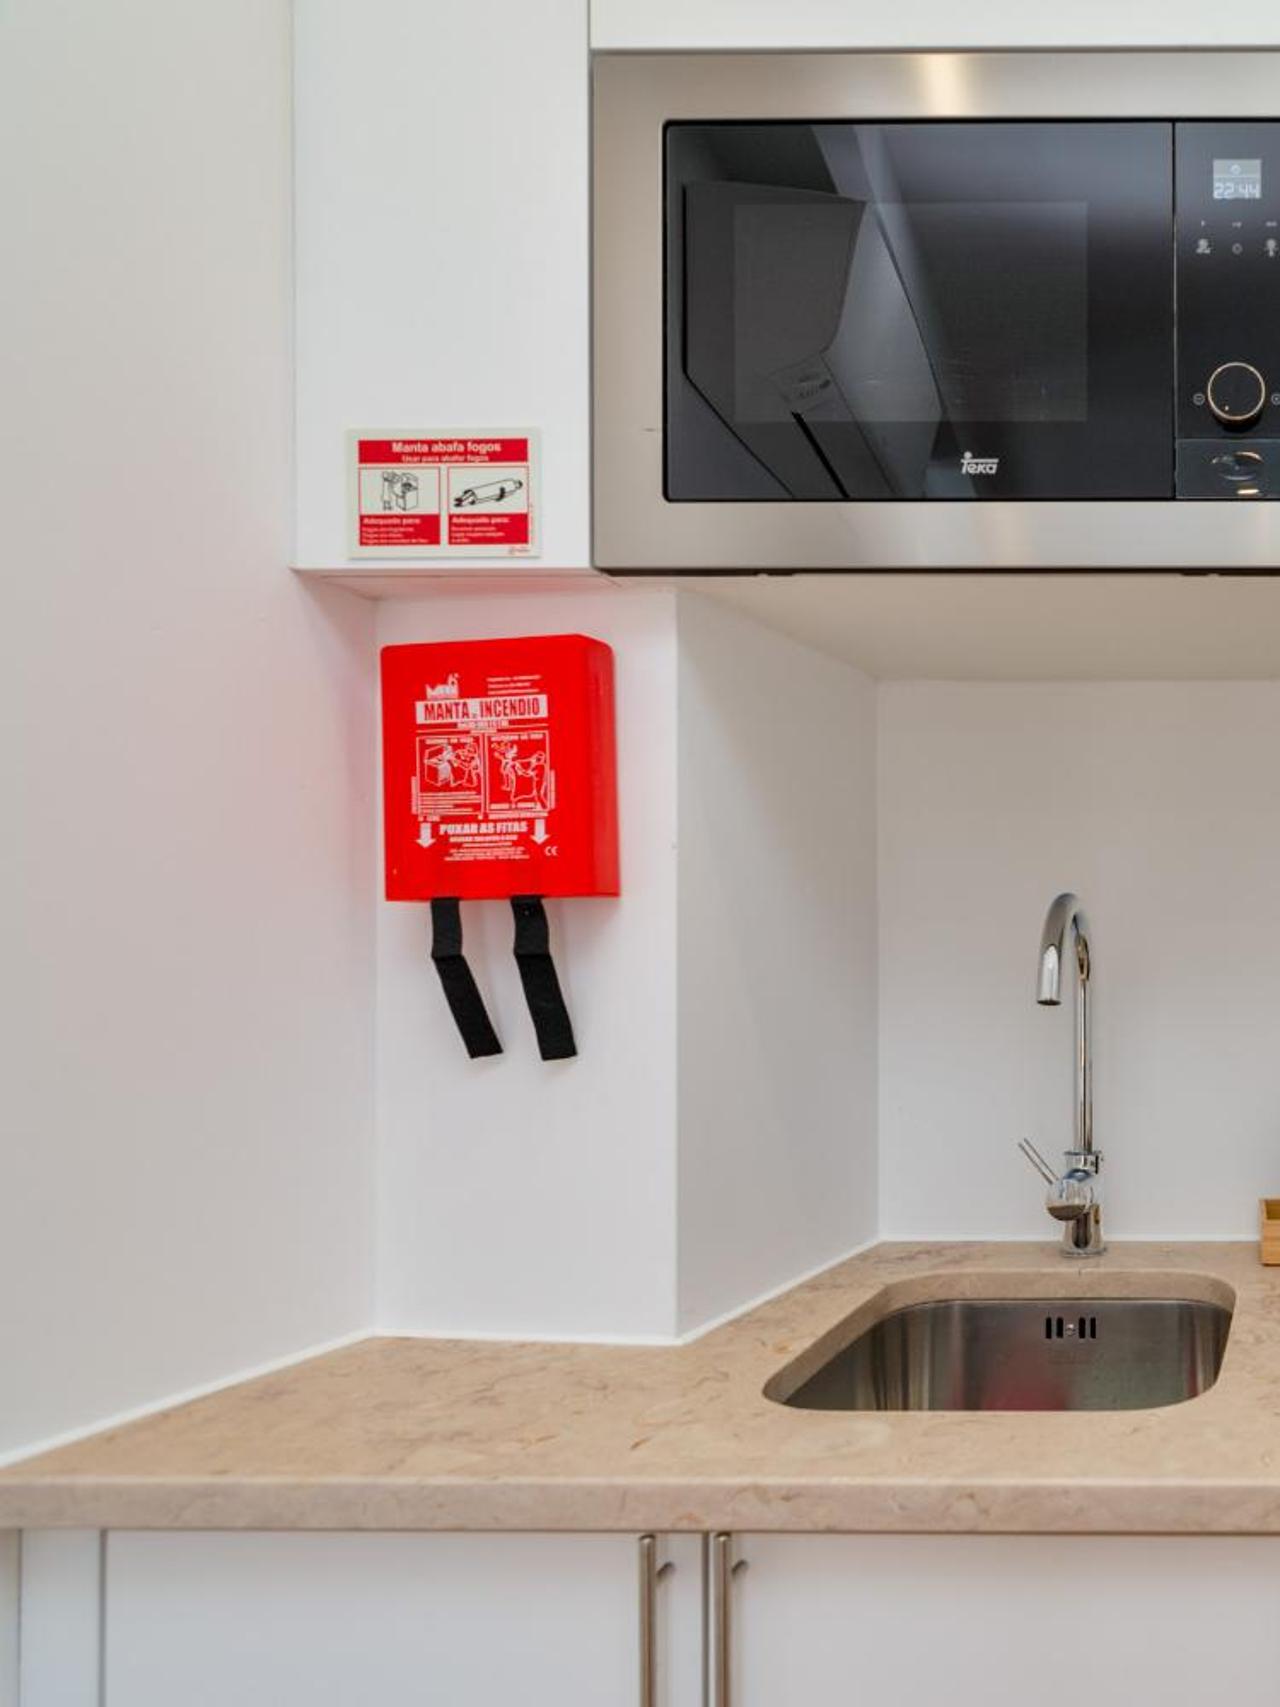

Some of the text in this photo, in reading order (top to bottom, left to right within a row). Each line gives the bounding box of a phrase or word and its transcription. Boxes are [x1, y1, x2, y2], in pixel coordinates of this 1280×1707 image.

[1213, 182, 1261, 199] 22:44
[391, 441, 502, 454] Manta abafa fogos
[421, 455, 440, 463] para
[424, 701, 470, 722] MANTA
[439, 820, 529, 836] PUXAR AS FITAS
